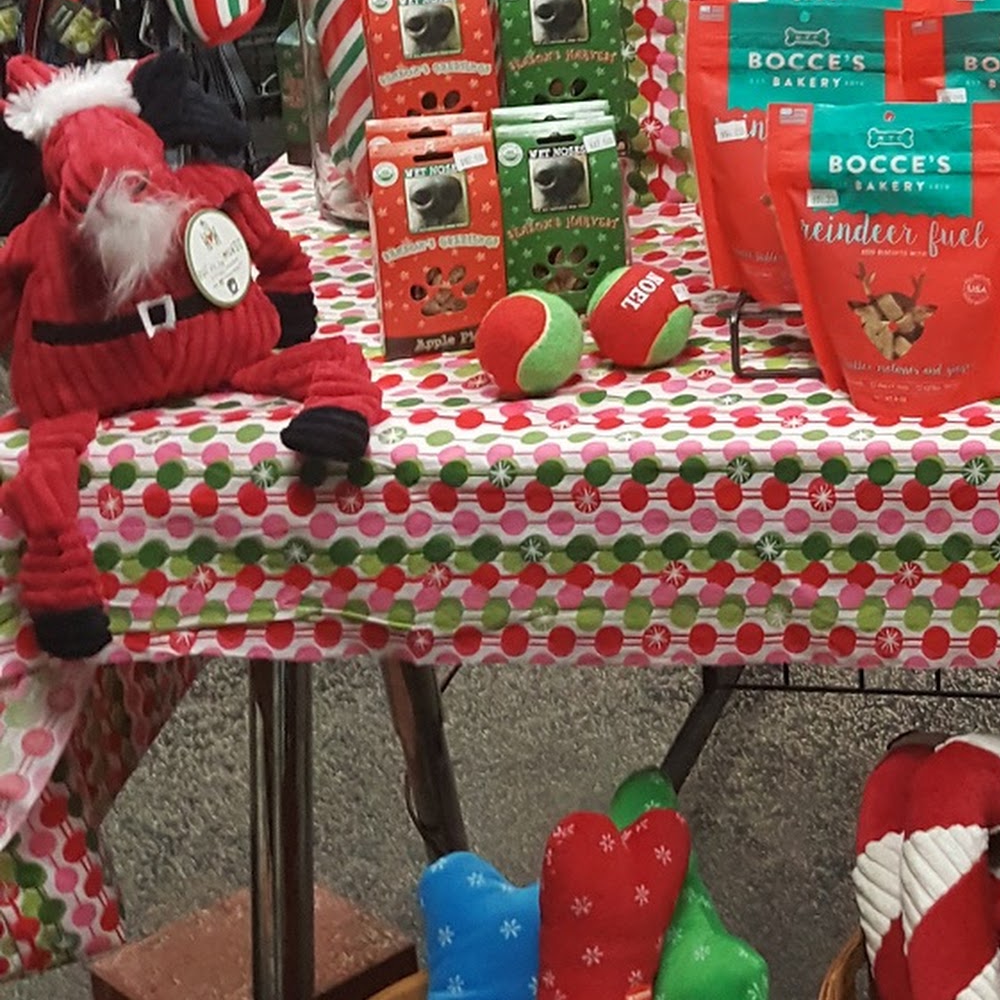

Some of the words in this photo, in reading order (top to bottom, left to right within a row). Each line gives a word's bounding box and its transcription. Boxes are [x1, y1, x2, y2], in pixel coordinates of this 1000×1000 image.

[565, 49, 617, 64] HARVEST
[748, 52, 866, 71] BOCCE'S
[773, 77, 842, 88] BAKERY
[828, 155, 952, 174] BOCCE'S
[854, 180, 926, 192] BAKERY
[565, 215, 620, 230] HARVEST
[800, 213, 919, 246] reindeer
[928, 220, 990, 258] fuel
[620, 270, 665, 311] NOEL
[414, 334, 457, 352] Apple
